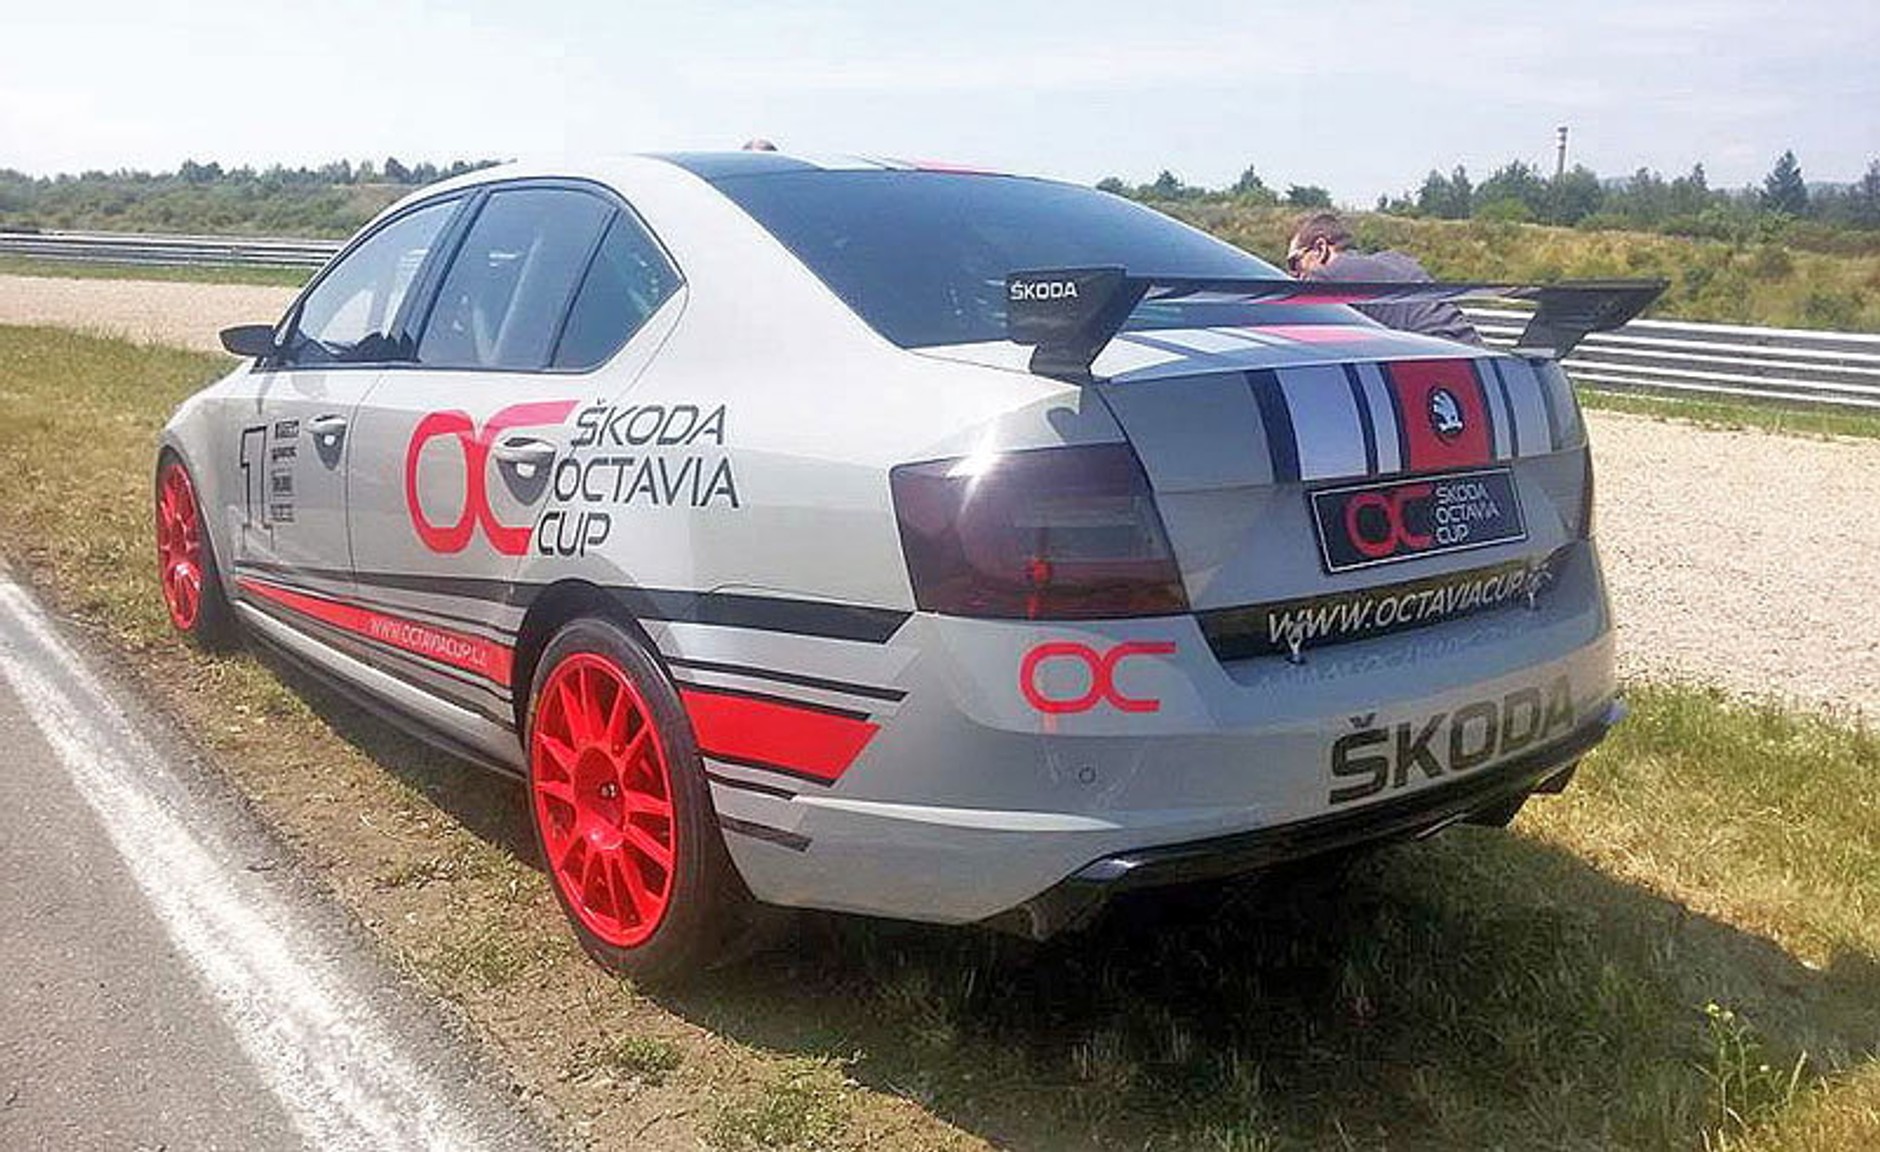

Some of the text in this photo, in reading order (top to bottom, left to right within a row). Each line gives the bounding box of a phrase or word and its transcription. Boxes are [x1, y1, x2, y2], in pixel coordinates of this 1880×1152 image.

[1009, 280, 1079, 301] ŠKODA
[570, 398, 727, 447] ŠKODA
[553, 456, 740, 509] OCTAVIA
[537, 511, 612, 558] CUP
[1346, 483, 1433, 558] OC
[1435, 503, 1500, 525] OCTAVIA
[1435, 523, 1469, 545] CUP
[1019, 640, 1177, 714] OC
[1328, 674, 1577, 805] ŠKODA
